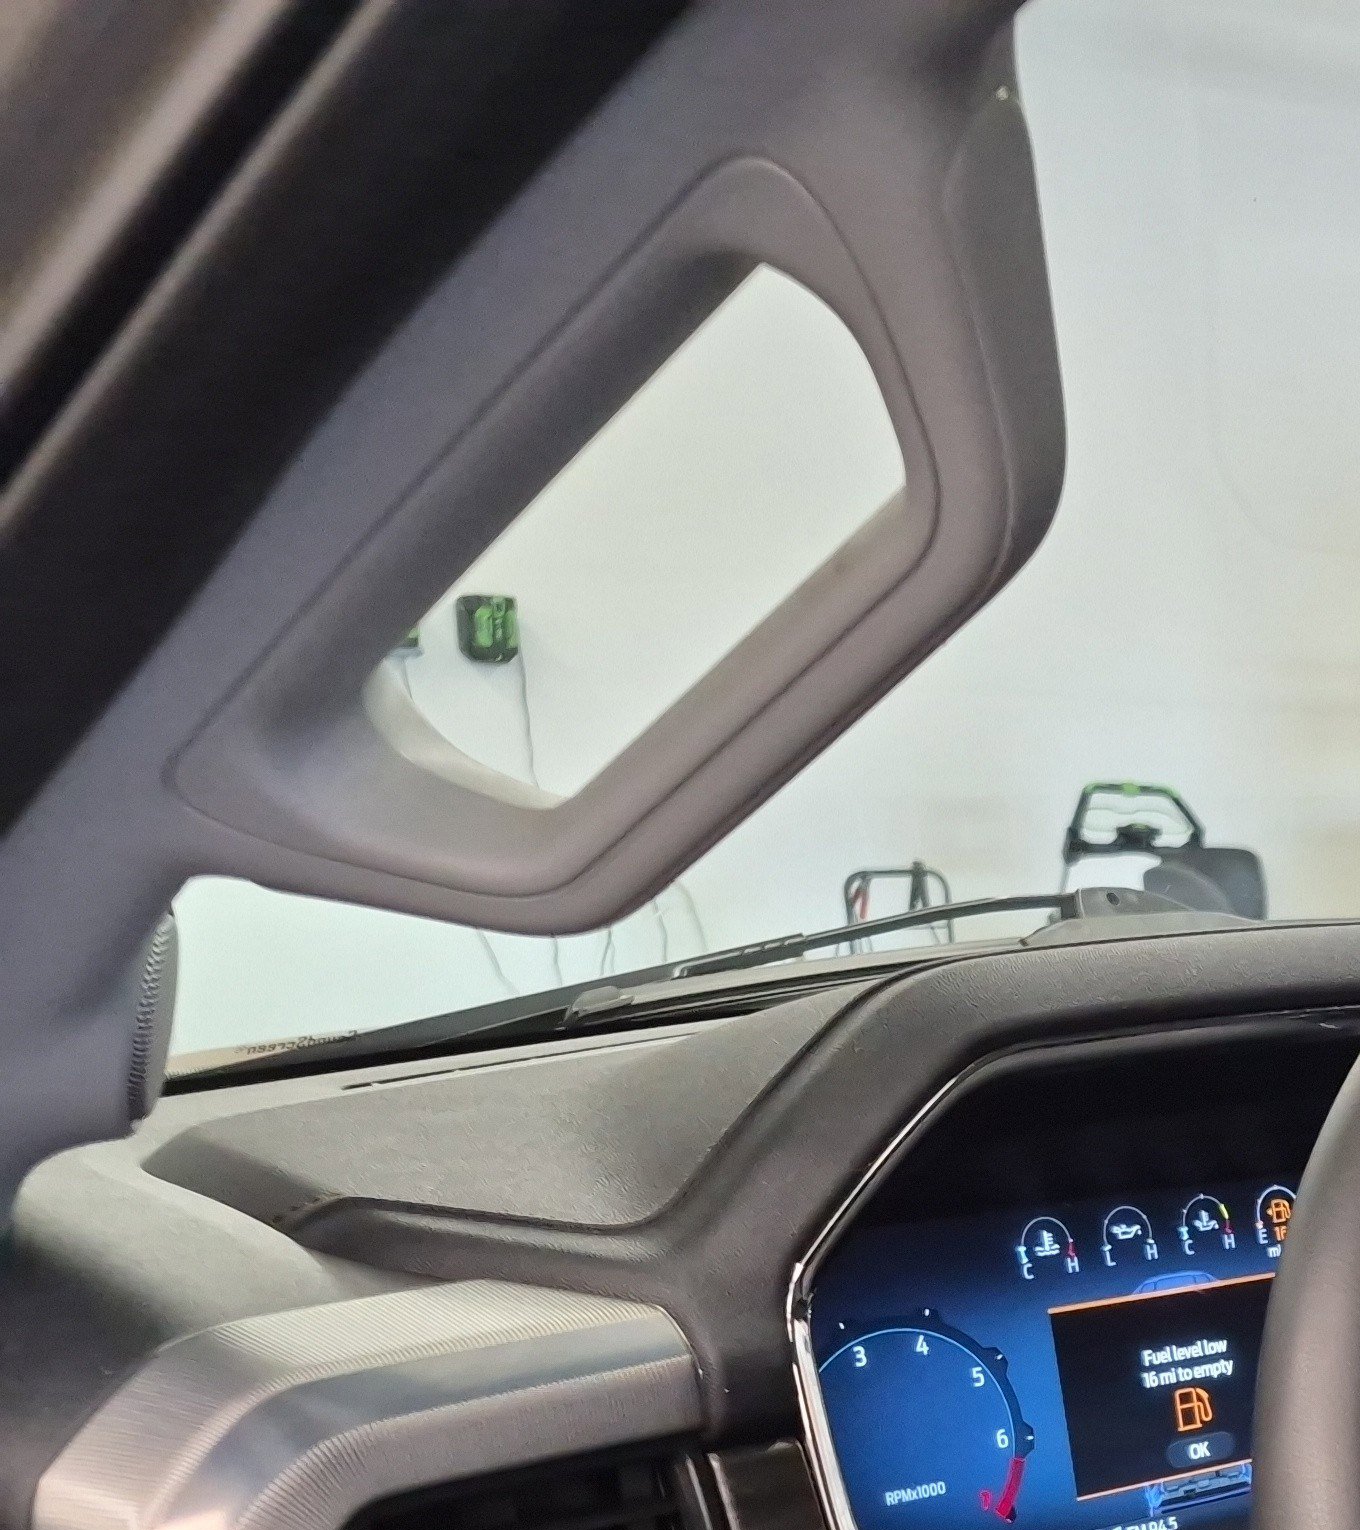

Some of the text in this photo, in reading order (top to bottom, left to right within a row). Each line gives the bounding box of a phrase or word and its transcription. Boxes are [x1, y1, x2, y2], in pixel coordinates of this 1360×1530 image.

[1222, 1233, 1236, 1250] H
[1259, 1228, 1268, 1244] E
[1145, 1242, 1159, 1260] H
[1182, 1239, 1194, 1255] C
[1021, 1263, 1034, 1280] C
[1065, 1256, 1080, 1273] H
[915, 1335, 929, 1356] 4
[1141, 1339, 1227, 1367] Fuel level low
[853, 1345, 868, 1368] 3
[971, 1367, 985, 1388] 5
[1141, 1358, 1234, 1389] 16 mi to empty
[995, 1429, 1009, 1449] 6
[1189, 1441, 1211, 1460] OK
[885, 1481, 946, 1507] RPMx1000
